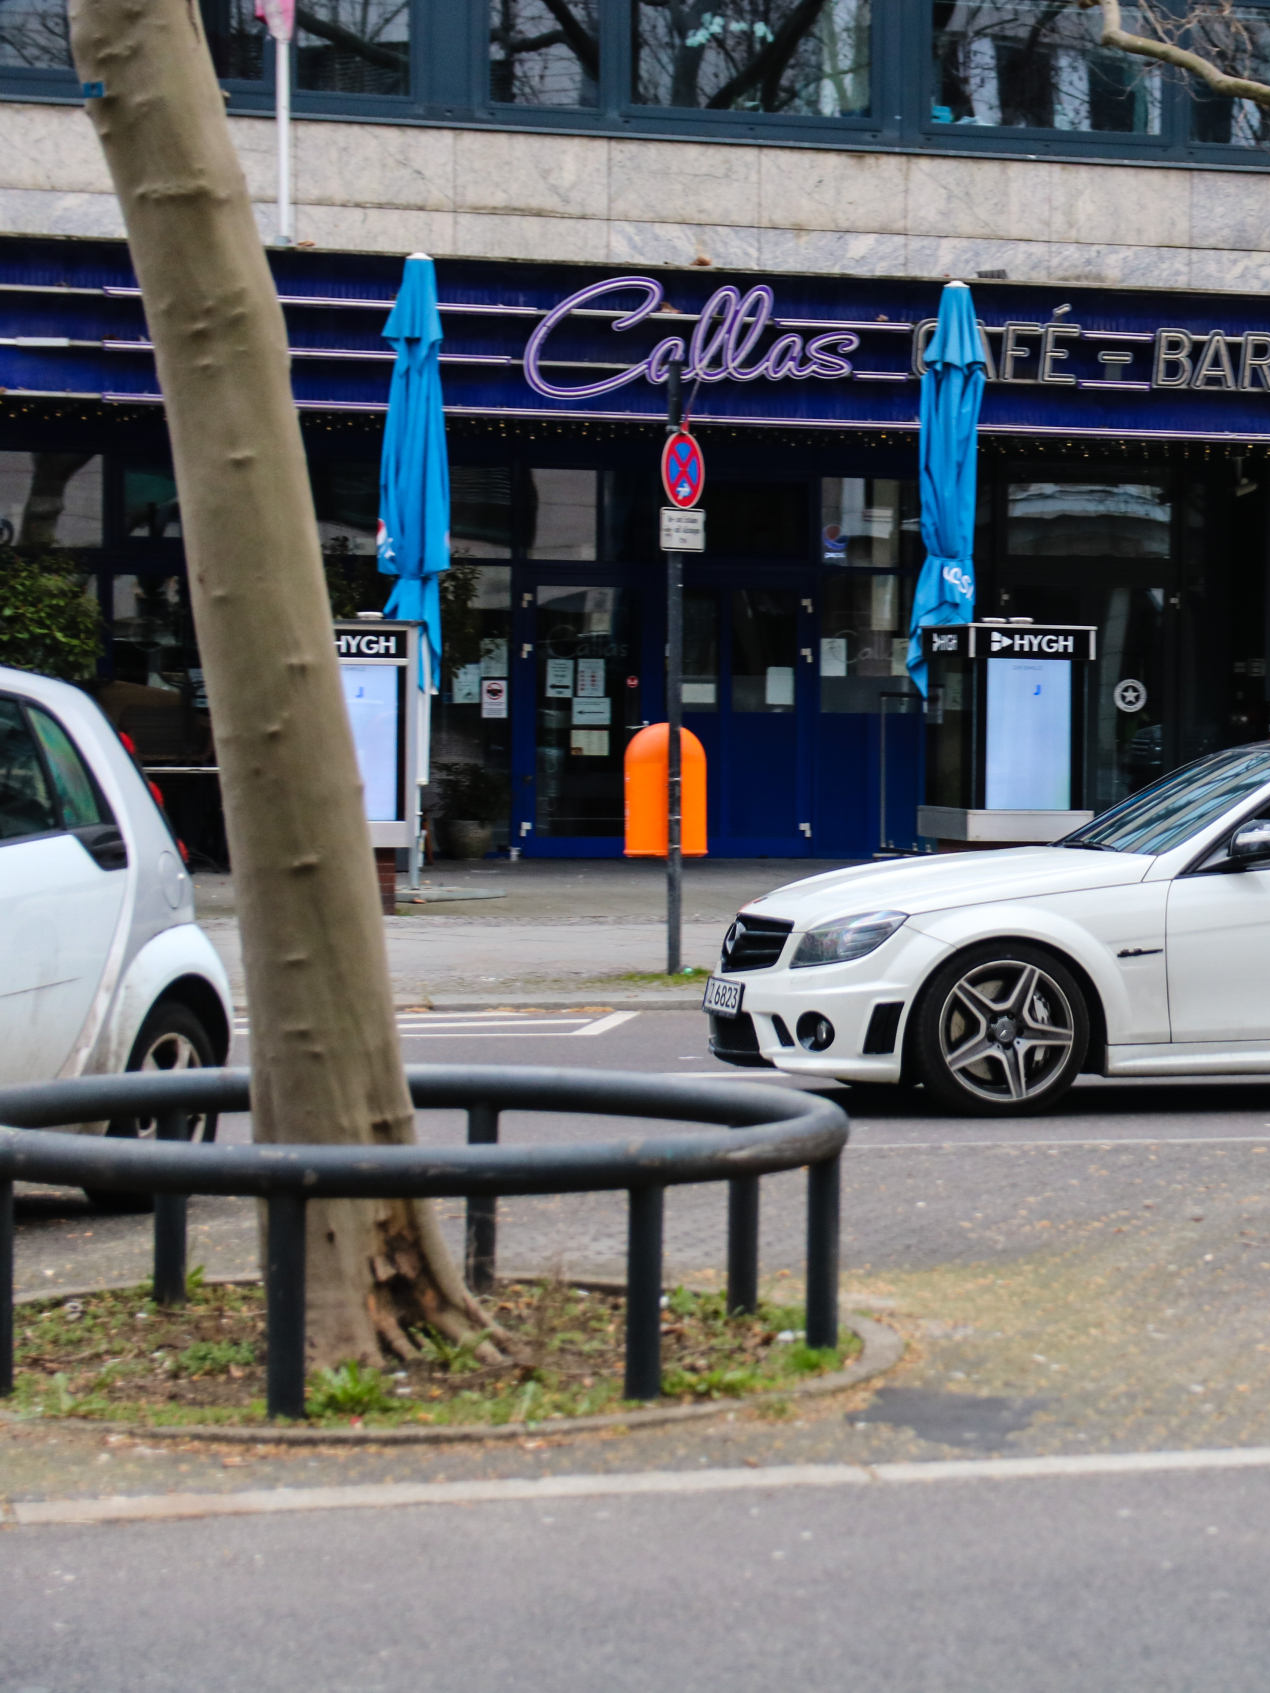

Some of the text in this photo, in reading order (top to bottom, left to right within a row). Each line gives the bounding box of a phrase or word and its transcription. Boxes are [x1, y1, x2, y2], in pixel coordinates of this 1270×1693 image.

[523, 276, 860, 399] Callas
[1013, 634, 1074, 653] HYGH
[714, 983, 738, 1009] 6823
